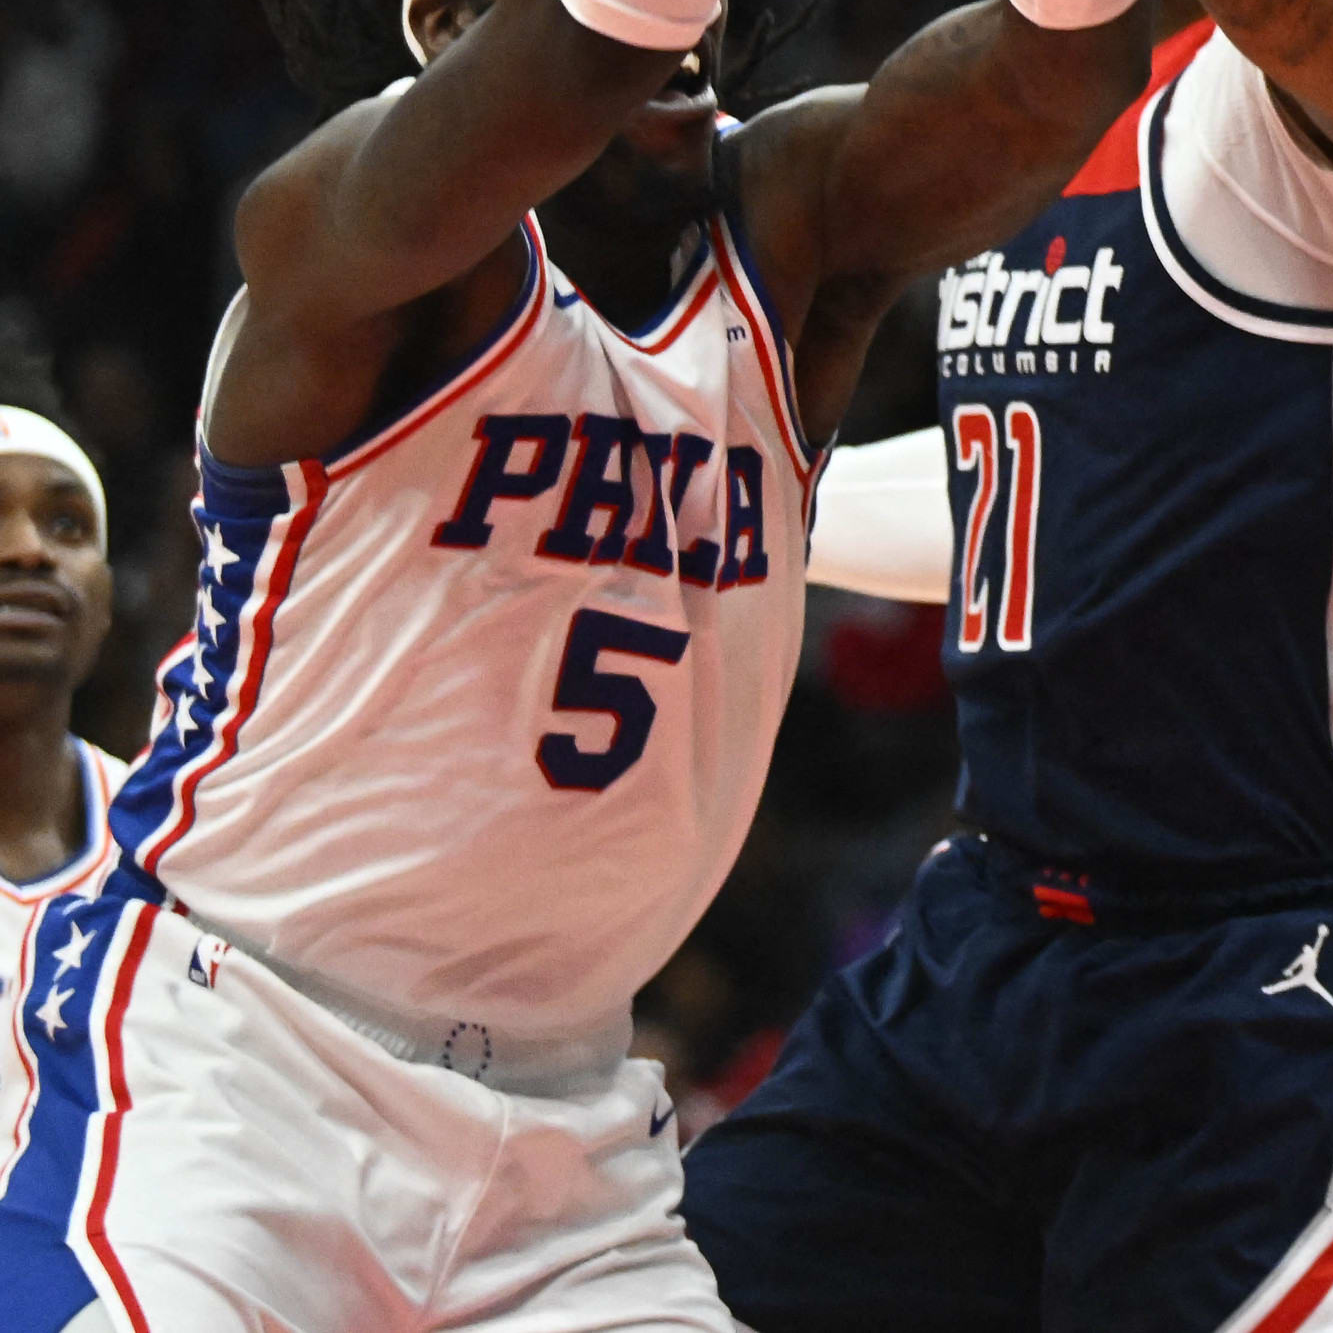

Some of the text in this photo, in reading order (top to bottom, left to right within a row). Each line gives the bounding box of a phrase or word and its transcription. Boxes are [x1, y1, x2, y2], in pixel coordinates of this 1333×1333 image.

[430, 412, 769, 593] PHILA
[953, 402, 1041, 653] 21
[536, 608, 691, 794] 5
